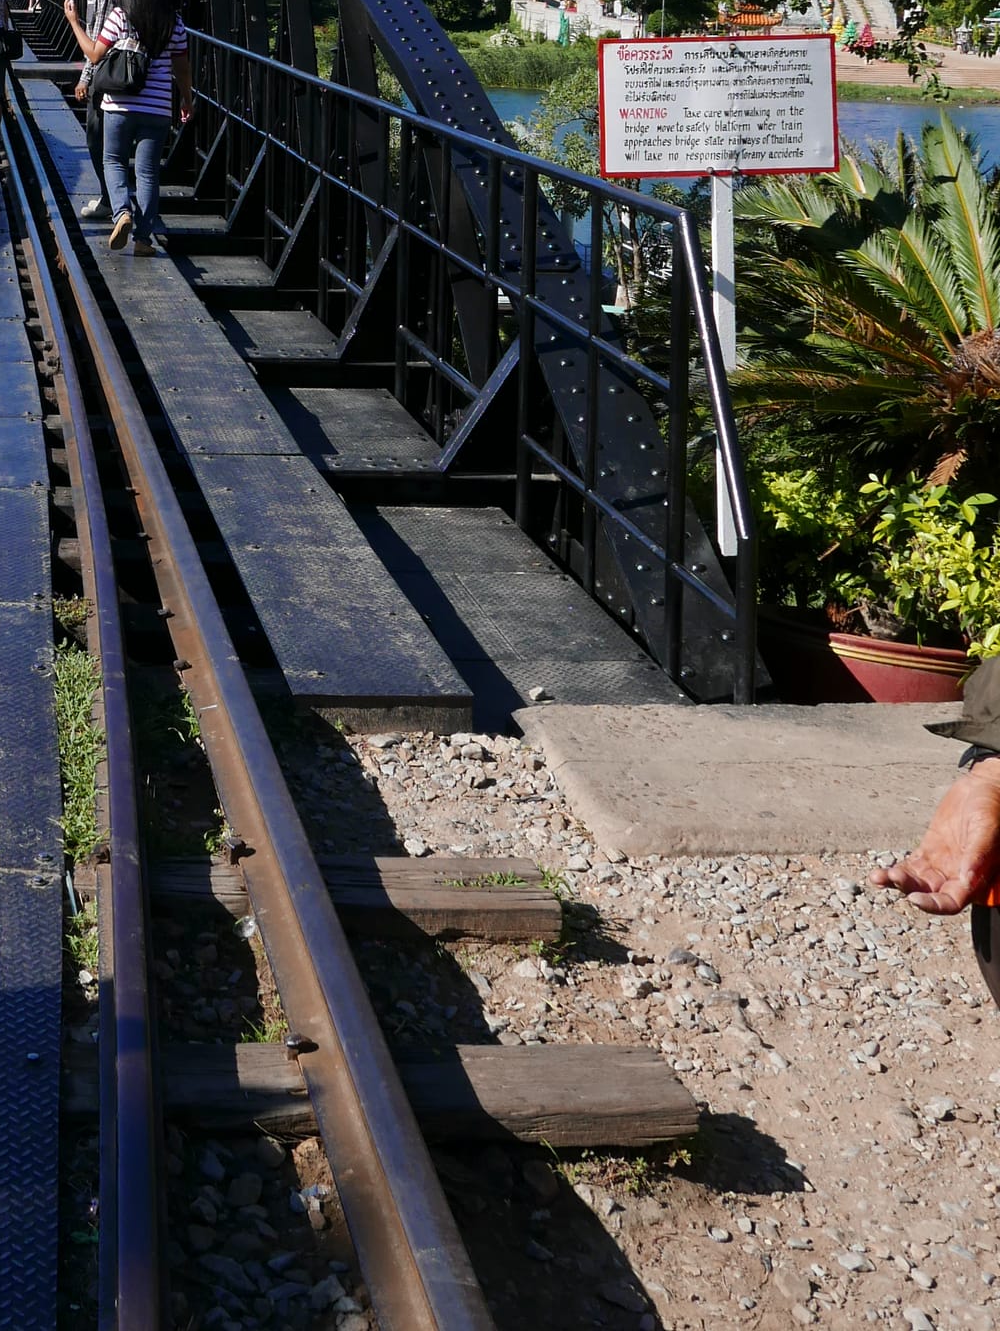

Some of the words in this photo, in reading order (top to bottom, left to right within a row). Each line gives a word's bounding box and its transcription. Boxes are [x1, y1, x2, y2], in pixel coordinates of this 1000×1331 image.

[619, 107, 668, 120] WARNING
[682, 107, 702, 118] Take
[703, 108, 722, 118] care
[723, 108, 743, 118] when
[743, 106, 771, 121] walking
[776, 108, 786, 117] on
[789, 105, 805, 116] the
[624, 121, 650, 136] bridge
[675, 121, 684, 133] to
[686, 121, 710, 134] safety
[781, 120, 803, 131] train
[624, 135, 672, 150] approaches
[674, 135, 700, 150] bridge
[704, 136, 724, 146] state
[728, 134, 761, 148] railways
[762, 133, 771, 145] of
[771, 132, 804, 144] thailand
[624, 150, 640, 161] will
[644, 150, 663, 161] take
[668, 152, 679, 161] no
[768, 148, 804, 159] accidents
